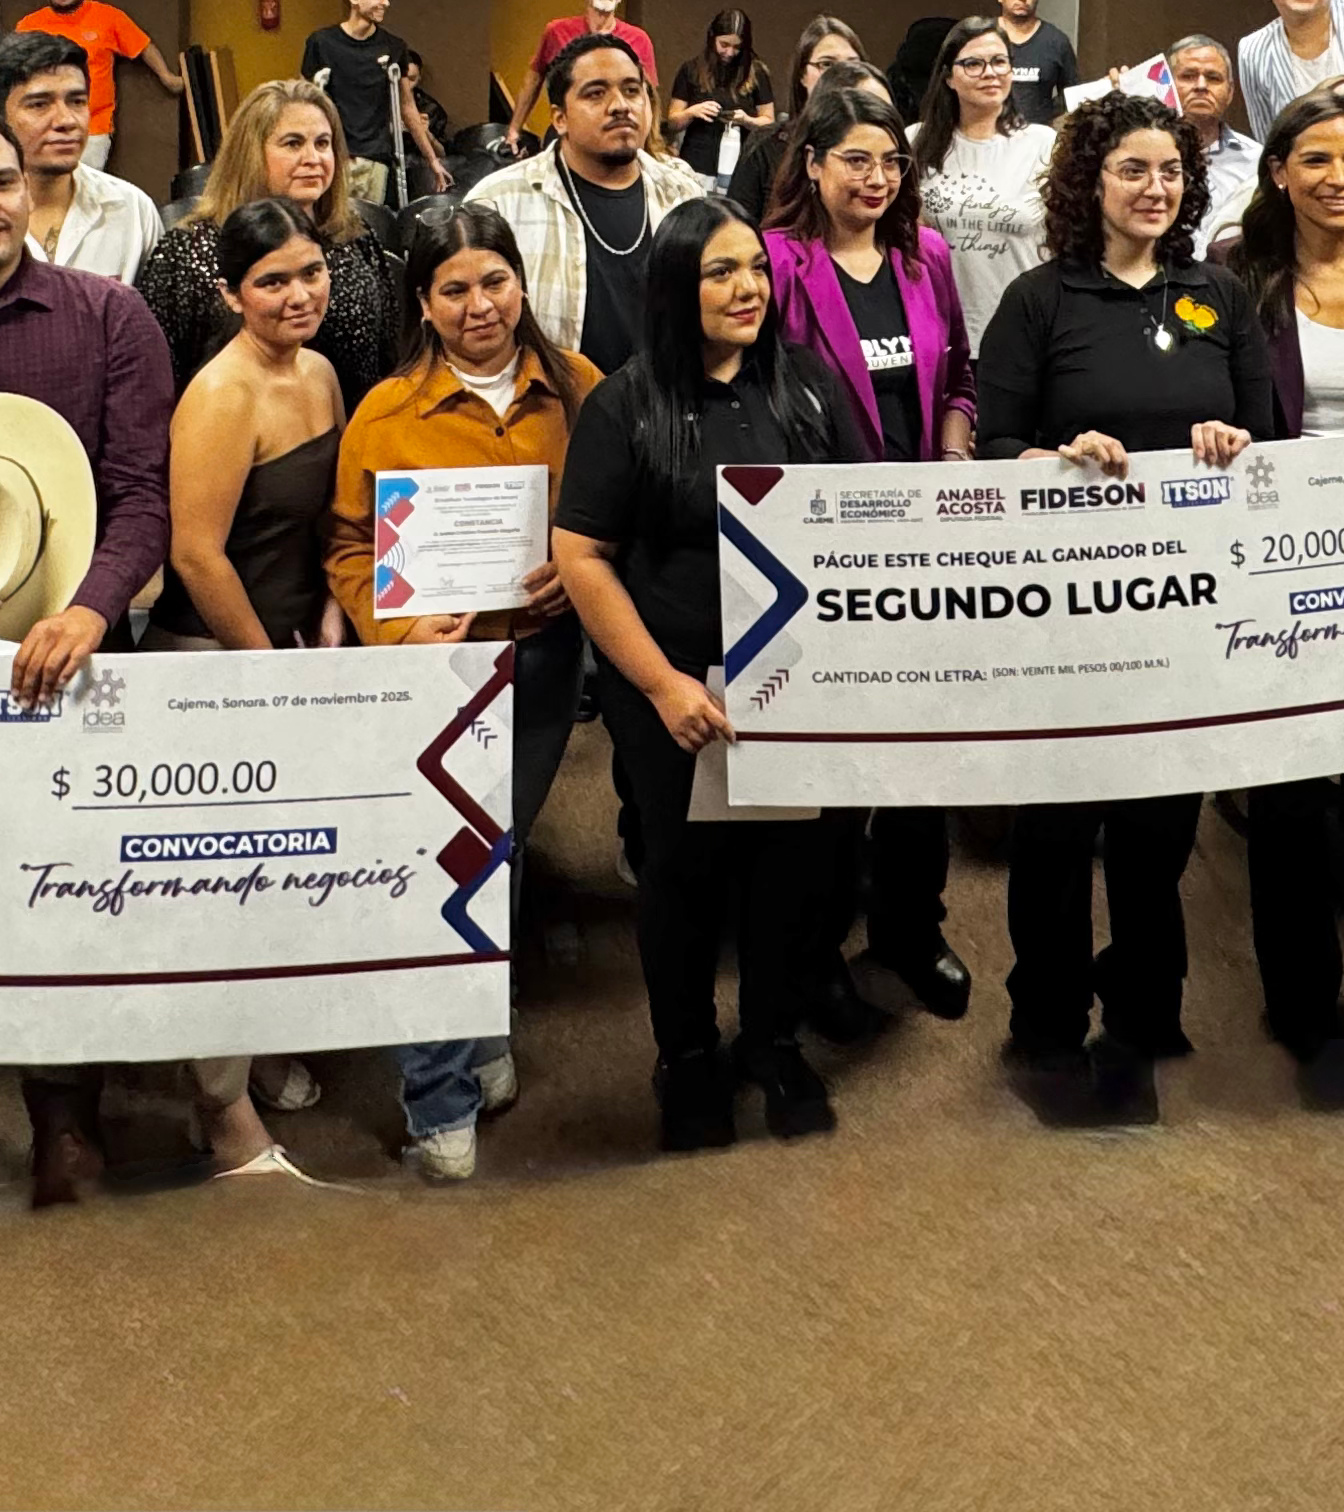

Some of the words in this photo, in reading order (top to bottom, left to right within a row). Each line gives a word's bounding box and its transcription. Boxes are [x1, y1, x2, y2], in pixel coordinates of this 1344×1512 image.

[958, 194, 1000, 217] find
[988, 205, 1018, 222] joy
[946, 217, 957, 228] IN
[961, 218, 983, 231] THE
[987, 221, 1024, 233] LITTLE
[957, 231, 1009, 259] things
[1163, 478, 1228, 502] ITSON
[1308, 475, 1344, 487] Cajeme,
[840, 488, 905, 499] SECRETARÍA
[908, 489, 922, 498] DE
[840, 499, 911, 509] DESARROLLO
[936, 488, 1006, 502] ANABEL
[1020, 482, 1145, 510] FIDESON
[1246, 489, 1279, 505] idea
[840, 507, 906, 519] ECONÓMICO
[936, 501, 1006, 516] ACOSTA
[813, 551, 879, 569] PÁGUE
[885, 553, 930, 568] ESTE
[936, 550, 1017, 568] CHEQUE
[1022, 549, 1047, 564] AL
[1052, 543, 1146, 563] GANADOR
[1153, 540, 1187, 555] DEL
[1230, 539, 1246, 569] $
[816, 583, 1051, 622] SEGUNDO
[1067, 572, 1217, 616] LUGAR
[812, 670, 892, 684] CANTIDAD
[896, 669, 930, 683] CON
[935, 667, 987, 682] LETRA:
[1022, 665, 1056, 676] VEINTE
[1058, 664, 1075, 675] MIL
[1078, 662, 1107, 674] PESOS
[1110, 659, 1142, 672] 00/100
[167, 697, 219, 712] Cajeme,
[272, 696, 289, 707] 07
[291, 695, 307, 706] de
[310, 692, 377, 705] noviembre
[381, 691, 413, 702] 2025.
[83, 707, 126, 726] idea
[50, 765, 71, 801] $
[93, 760, 277, 803] 30,000.00
[125, 831, 331, 859] CONVOCATORIA
